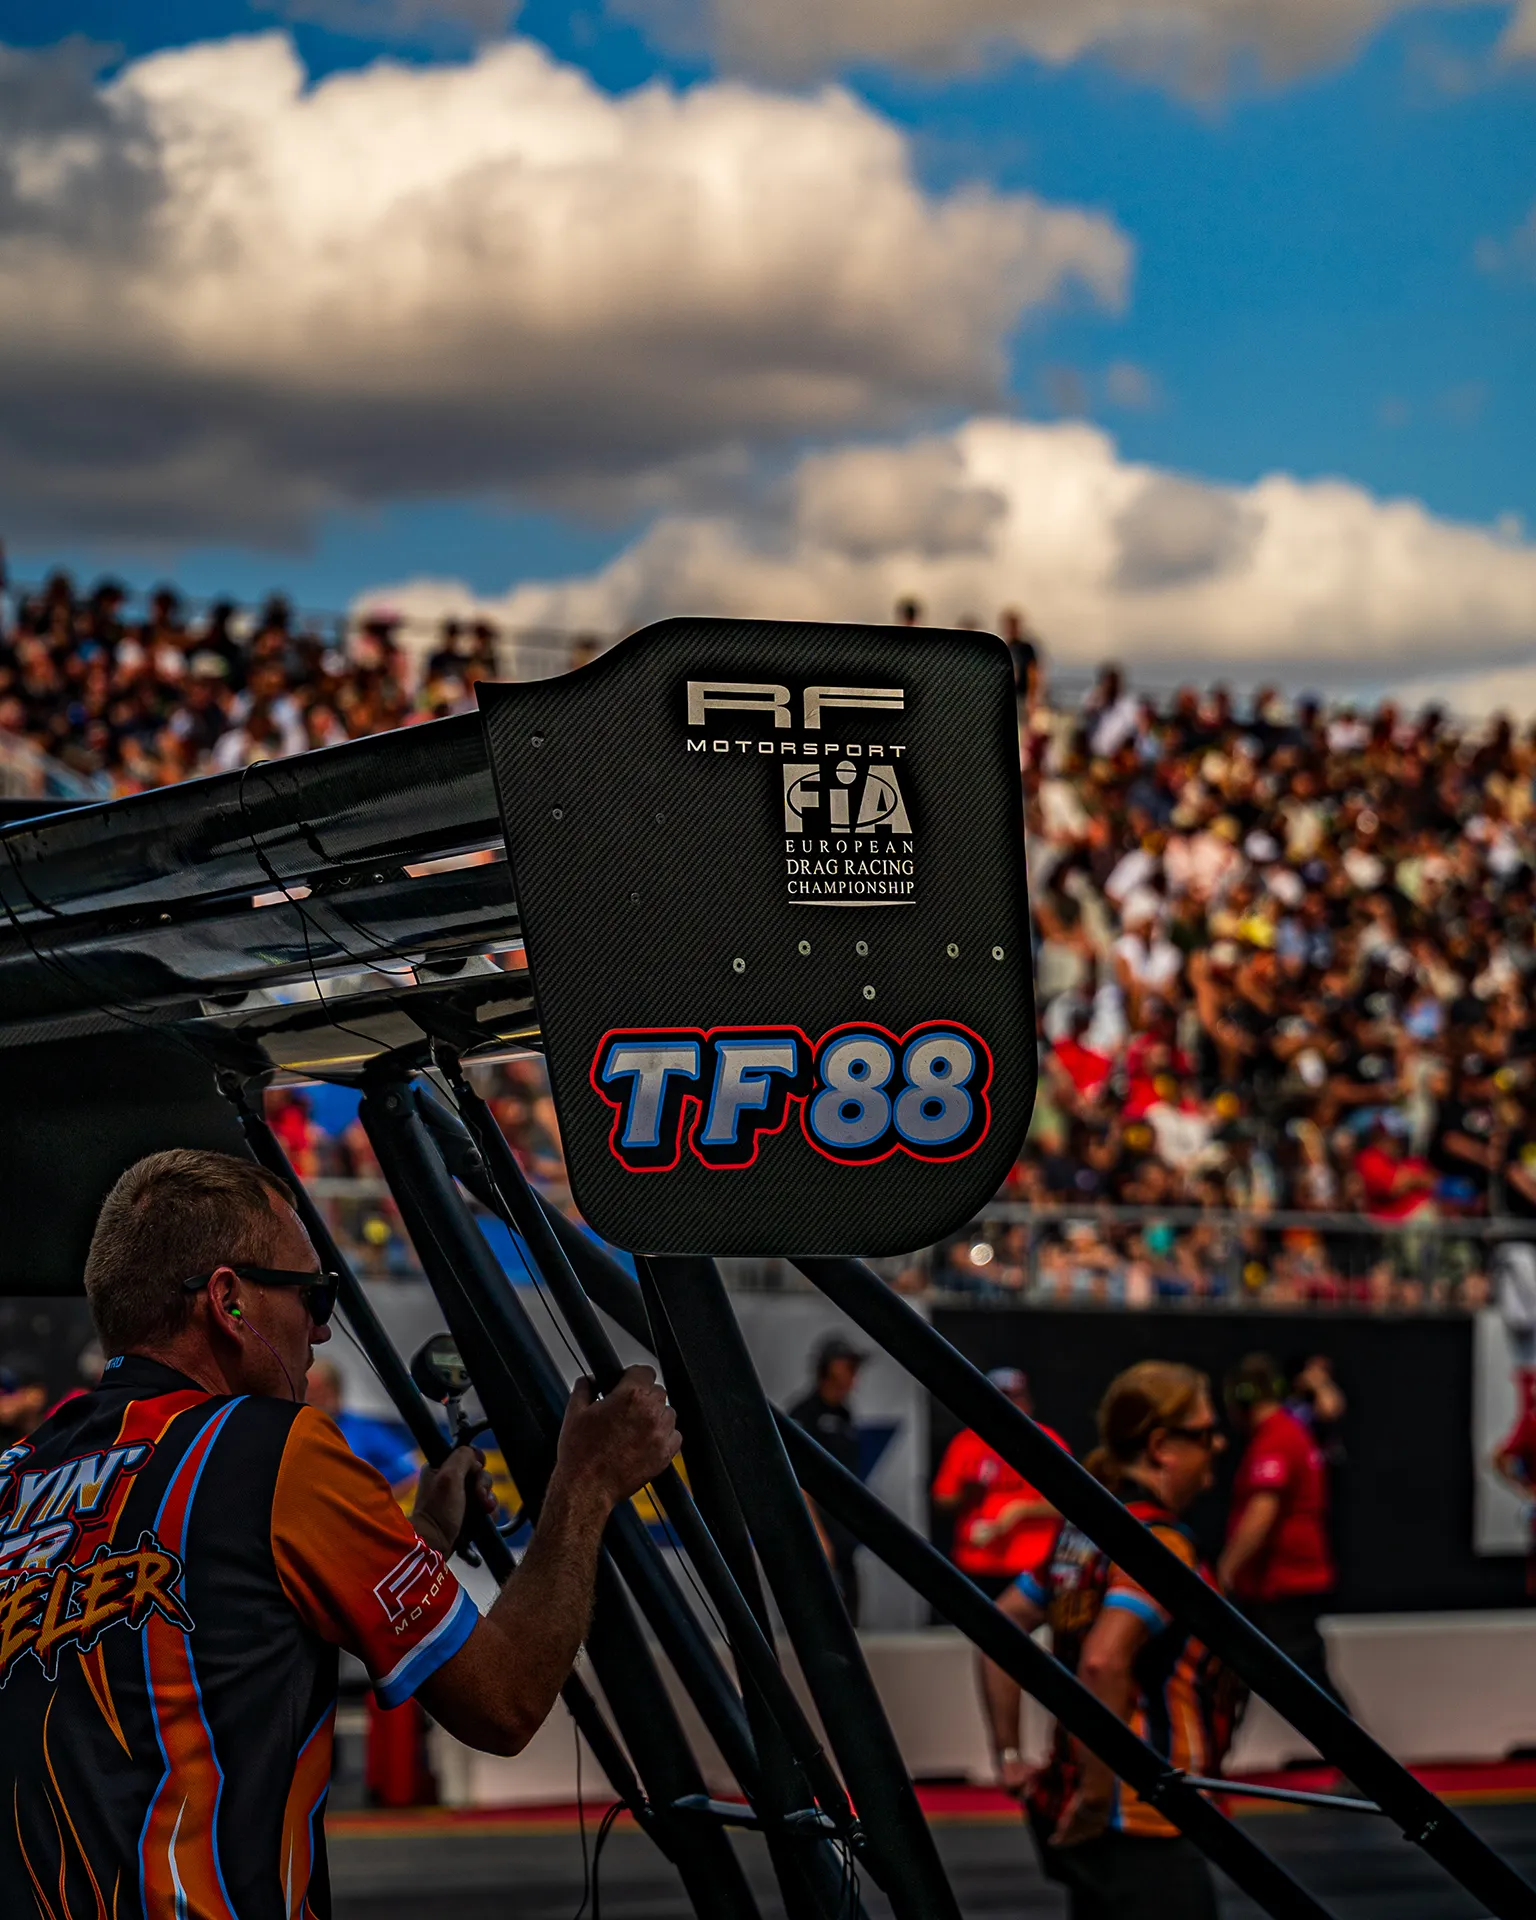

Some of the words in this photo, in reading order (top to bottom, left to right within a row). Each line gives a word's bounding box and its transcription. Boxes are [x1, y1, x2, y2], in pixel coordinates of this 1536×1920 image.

[687, 681, 904, 729] RF
[687, 739, 906, 757] MOTORSPORT
[785, 840, 914, 853] EUROPEAN
[786, 859, 838, 875] DRAG
[845, 860, 914, 875] RACING
[787, 881, 915, 894] CHAMPIONSHIP
